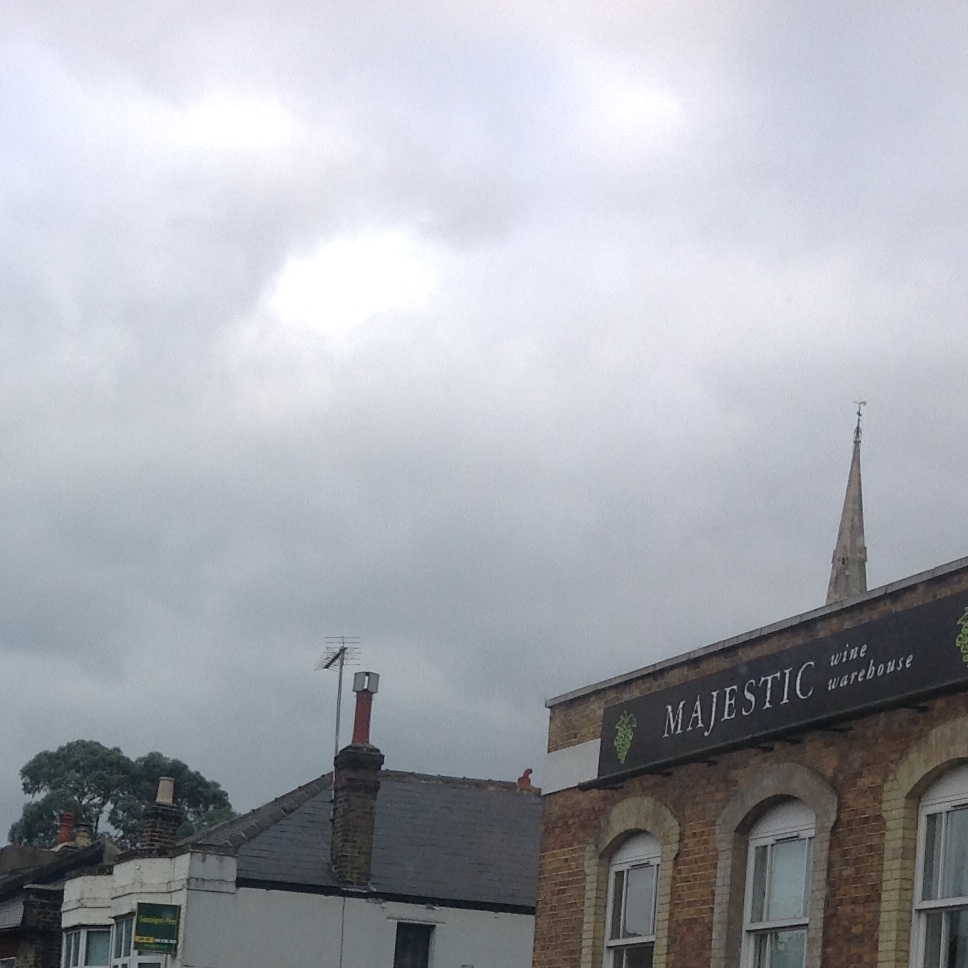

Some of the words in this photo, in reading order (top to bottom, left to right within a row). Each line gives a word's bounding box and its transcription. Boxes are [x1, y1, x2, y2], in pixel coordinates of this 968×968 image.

[827, 653, 914, 692] warehouse
[829, 643, 868, 668] wine
[662, 660, 816, 739] MAJESTIC
